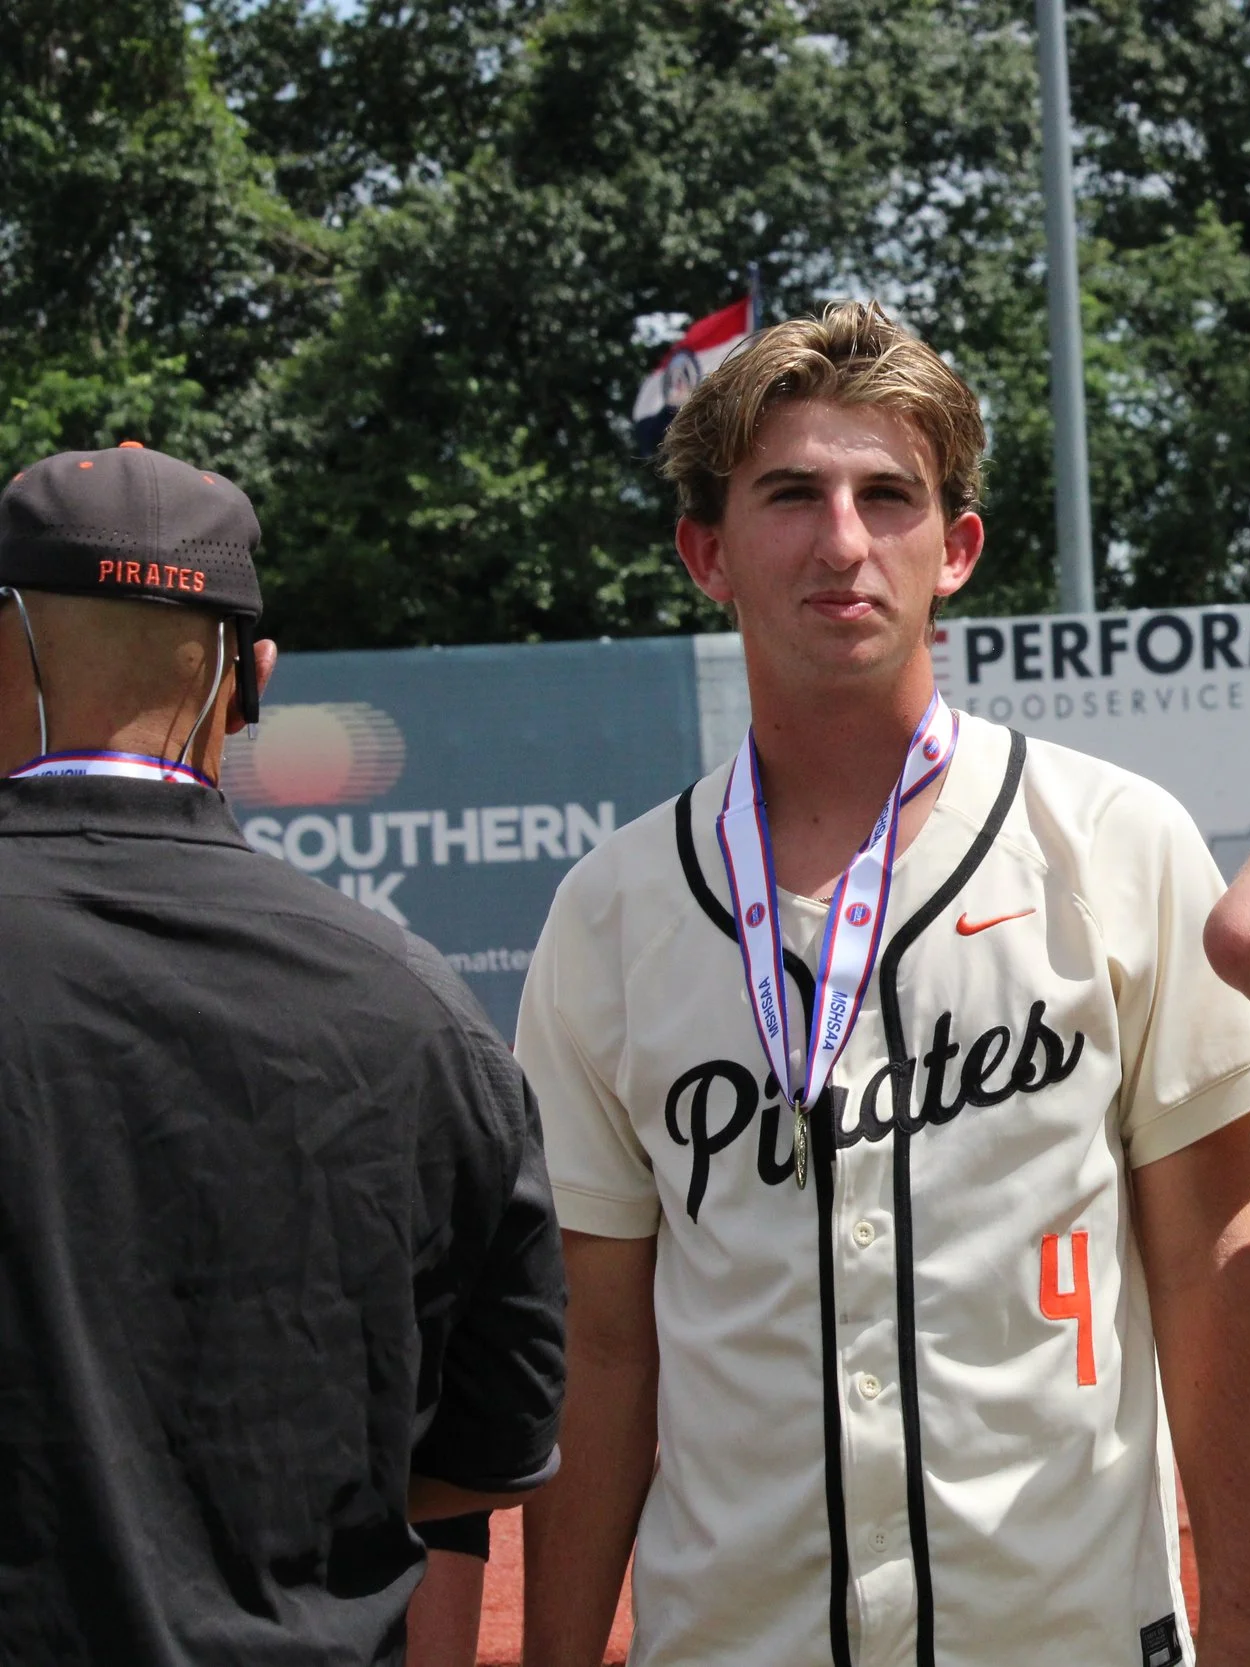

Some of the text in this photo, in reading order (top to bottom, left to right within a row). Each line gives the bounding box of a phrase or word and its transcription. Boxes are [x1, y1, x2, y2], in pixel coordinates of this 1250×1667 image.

[98, 559, 206, 592] PIRATES
[965, 682, 1244, 724] FOODSERVICE
[243, 801, 616, 873] SOUTHERN
[758, 976, 780, 1039] MSHSAA
[822, 990, 849, 1051] MSHSAA
[1039, 1231, 1098, 1386] 4
